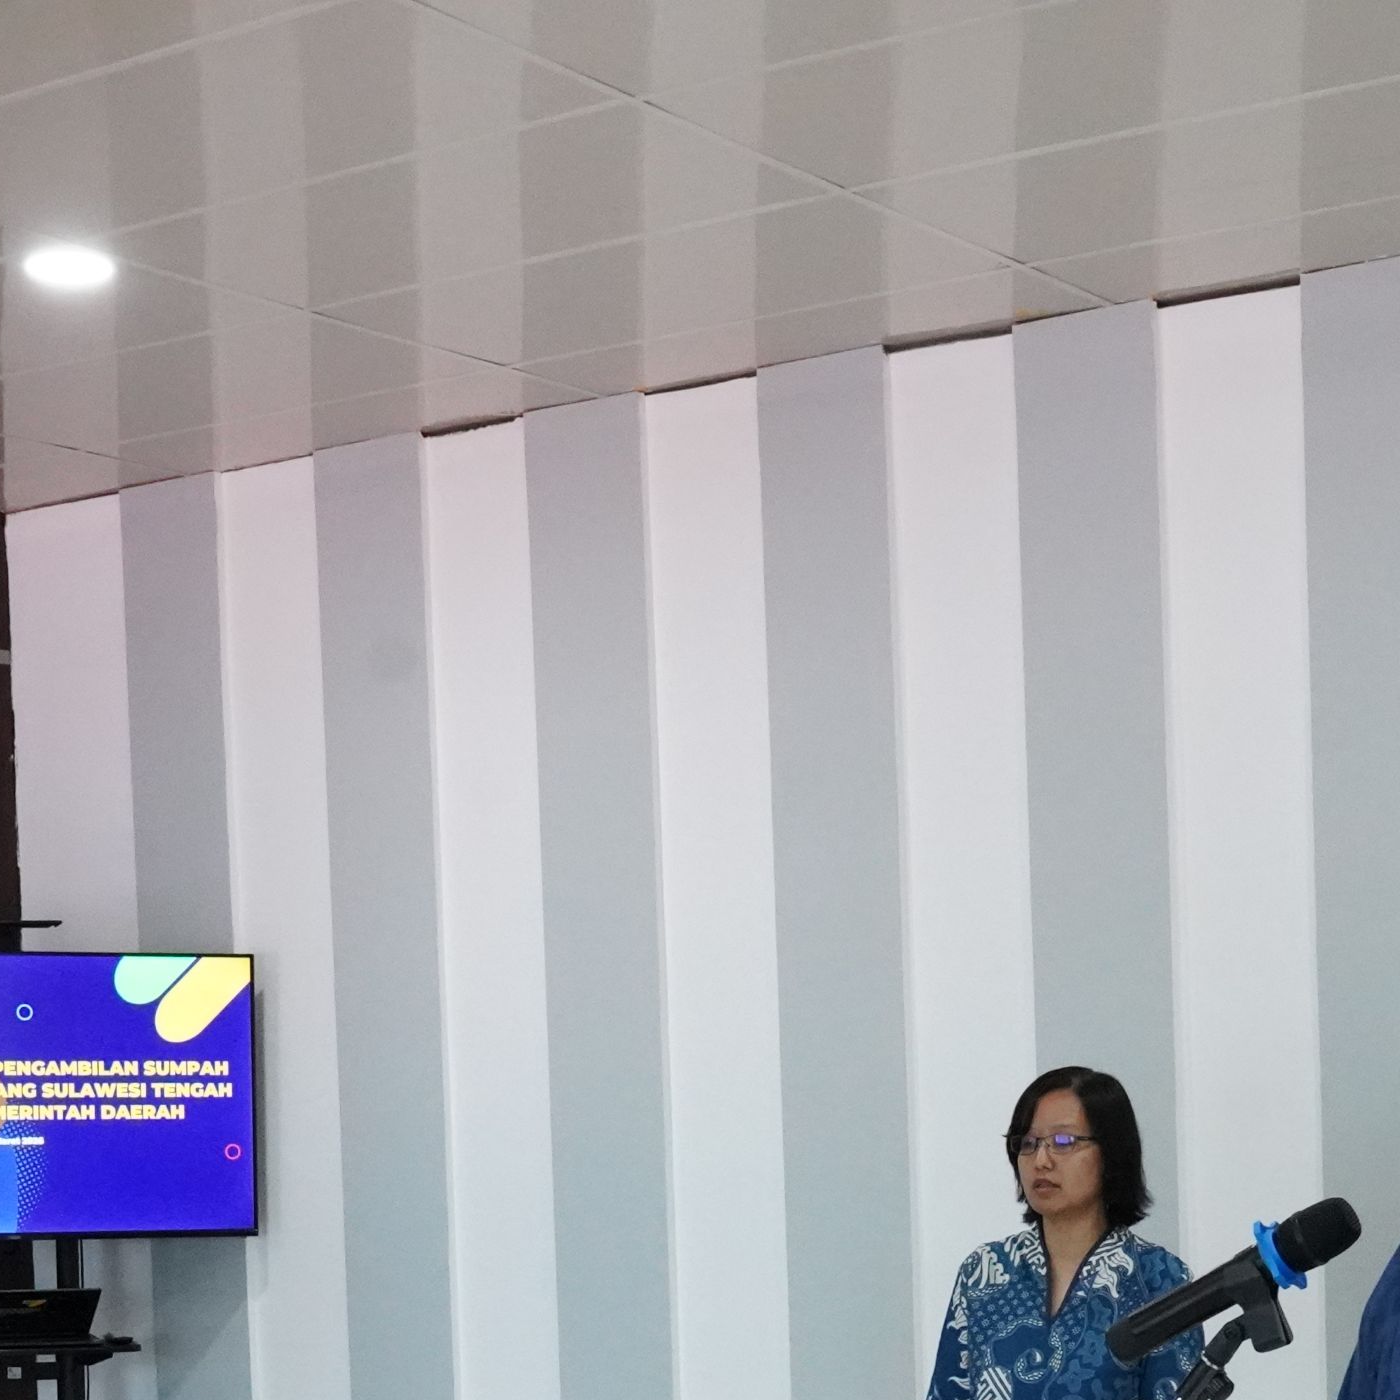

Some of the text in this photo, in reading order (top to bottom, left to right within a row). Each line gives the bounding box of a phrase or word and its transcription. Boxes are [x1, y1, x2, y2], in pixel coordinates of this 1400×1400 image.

[143, 1060, 229, 1076] SUMPAH
[41, 1082, 147, 1098] SULAWESI
[151, 1082, 233, 1098] TENGAH
[101, 1104, 185, 1119] DAERAH
